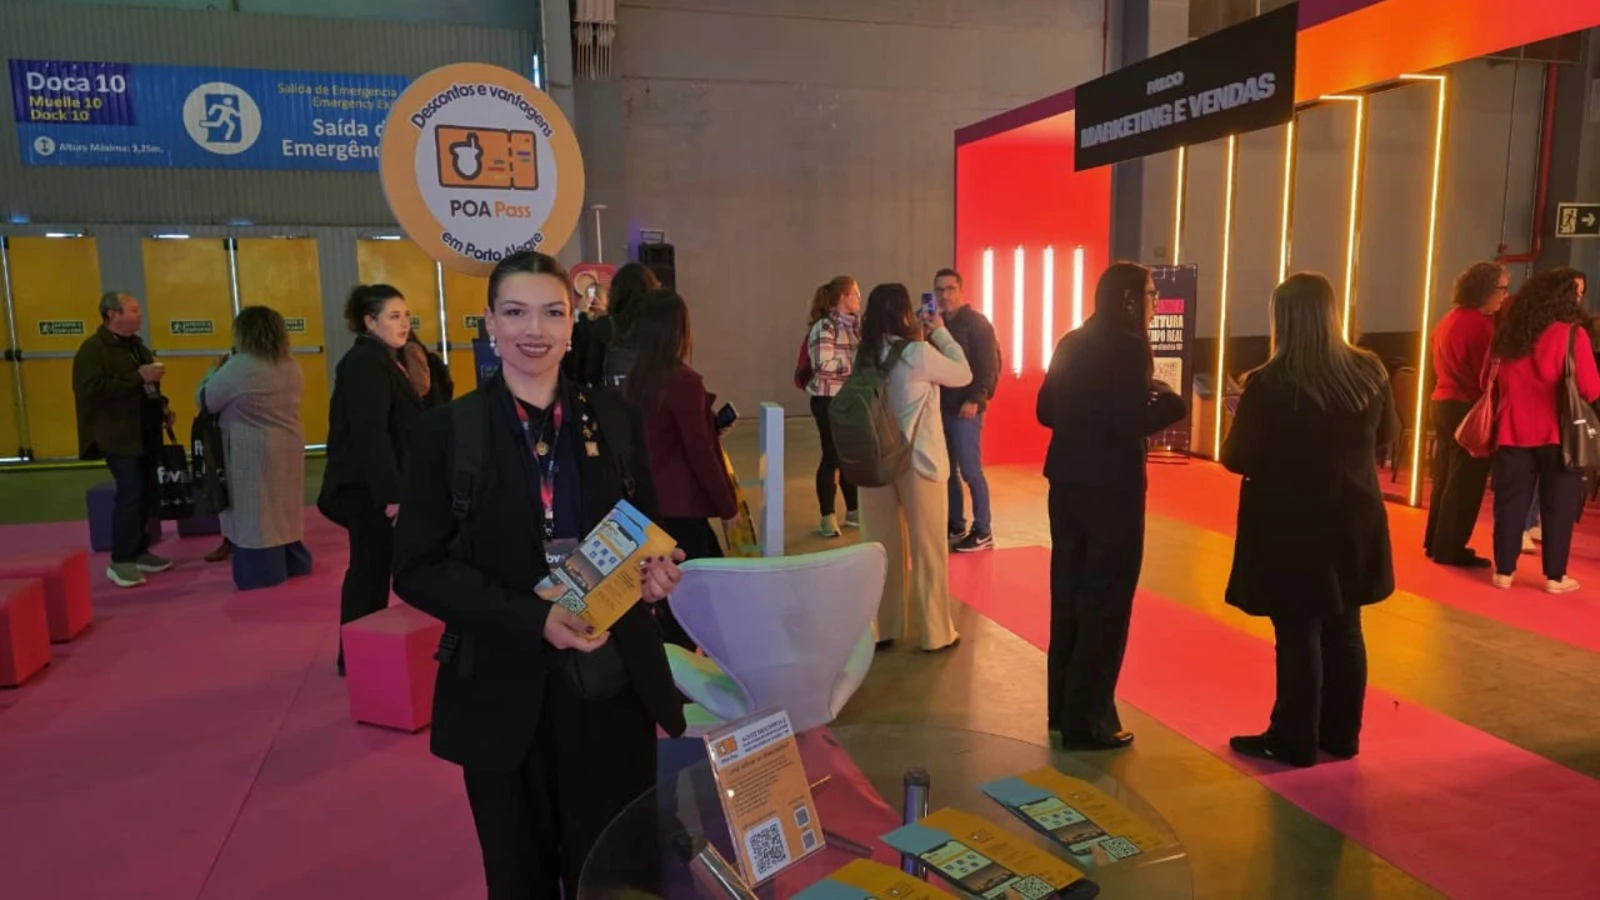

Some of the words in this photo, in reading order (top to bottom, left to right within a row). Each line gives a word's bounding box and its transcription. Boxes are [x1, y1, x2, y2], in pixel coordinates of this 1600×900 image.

[26, 72, 91, 92] Doca
[95, 74, 126, 93] 10
[278, 83, 312, 94] Salida
[315, 85, 329, 94] de
[333, 85, 398, 98] Emergencia
[29, 95, 81, 108] Muelle
[85, 98, 102, 109] 10
[313, 97, 375, 110] Emergency
[411, 84, 475, 129] Descontos
[477, 84, 487, 96] e
[489, 86, 553, 138] vantagens
[1081, 103, 1173, 148] MARKETING
[1174, 98, 1187, 122] E
[1188, 72, 1276, 118] VENDAS
[31, 109, 67, 120] Dock
[72, 110, 90, 121] 10
[312, 118, 369, 137] Saída
[281, 139, 381, 161] Emergênc
[450, 200, 492, 217] POA
[495, 201, 532, 218] Pass
[442, 231, 464, 252] em
[464, 242, 502, 262] Porto
